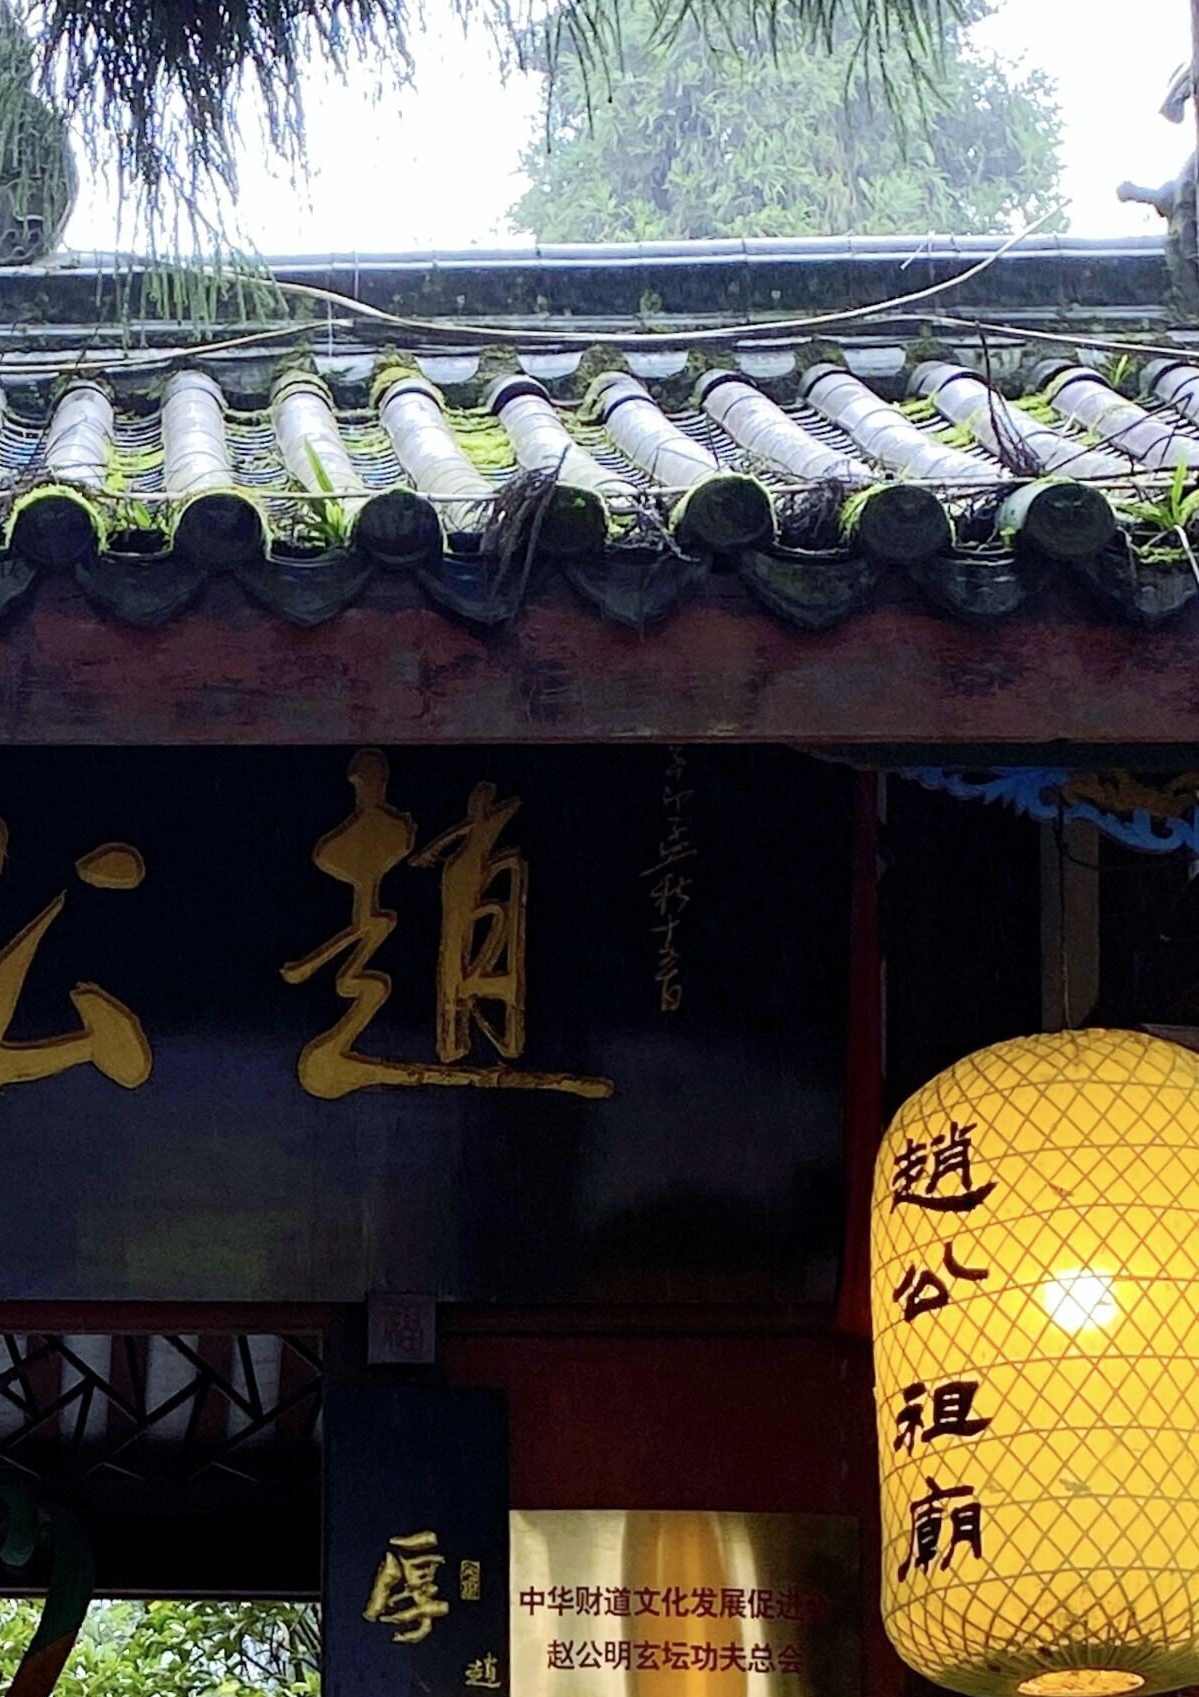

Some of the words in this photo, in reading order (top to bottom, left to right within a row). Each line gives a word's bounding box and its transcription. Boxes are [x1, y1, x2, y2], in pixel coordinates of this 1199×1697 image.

[889, 1121, 997, 1582] 趙公祖廟
[519, 1585, 828, 1620] 中华财道文化发展促进
[547, 1640, 803, 1674] 赵公明玄坛功夫总会
